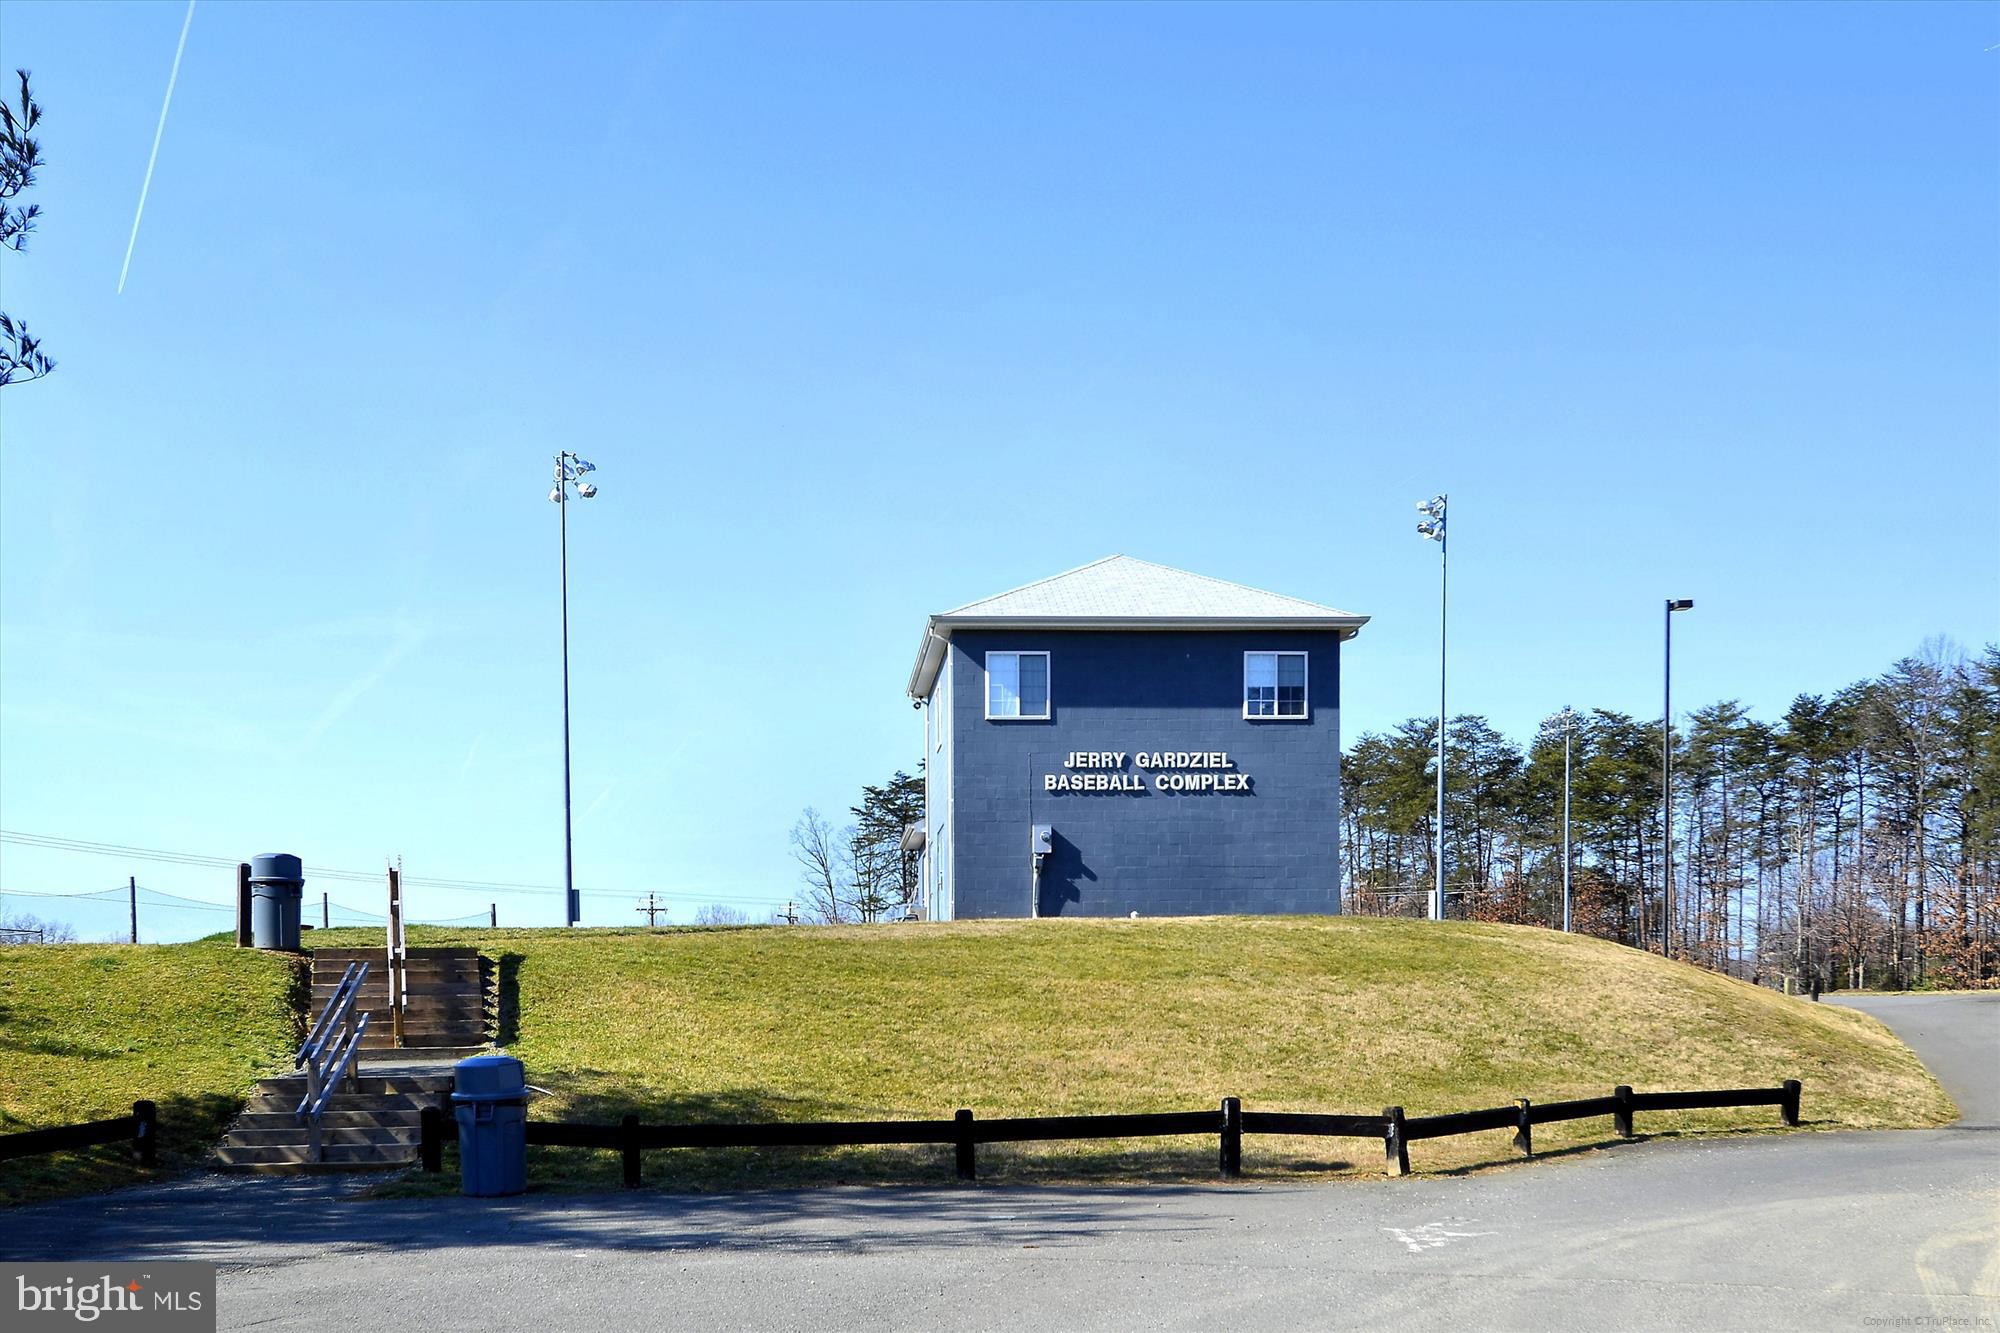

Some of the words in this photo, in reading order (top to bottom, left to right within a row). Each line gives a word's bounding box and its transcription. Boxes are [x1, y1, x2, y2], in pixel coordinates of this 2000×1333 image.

[1064, 752, 1126, 768] JERRY
[1135, 752, 1233, 768] GARDZIEL
[1044, 774, 1145, 790] BASEBALL
[1155, 774, 1250, 790] COMPLEX
